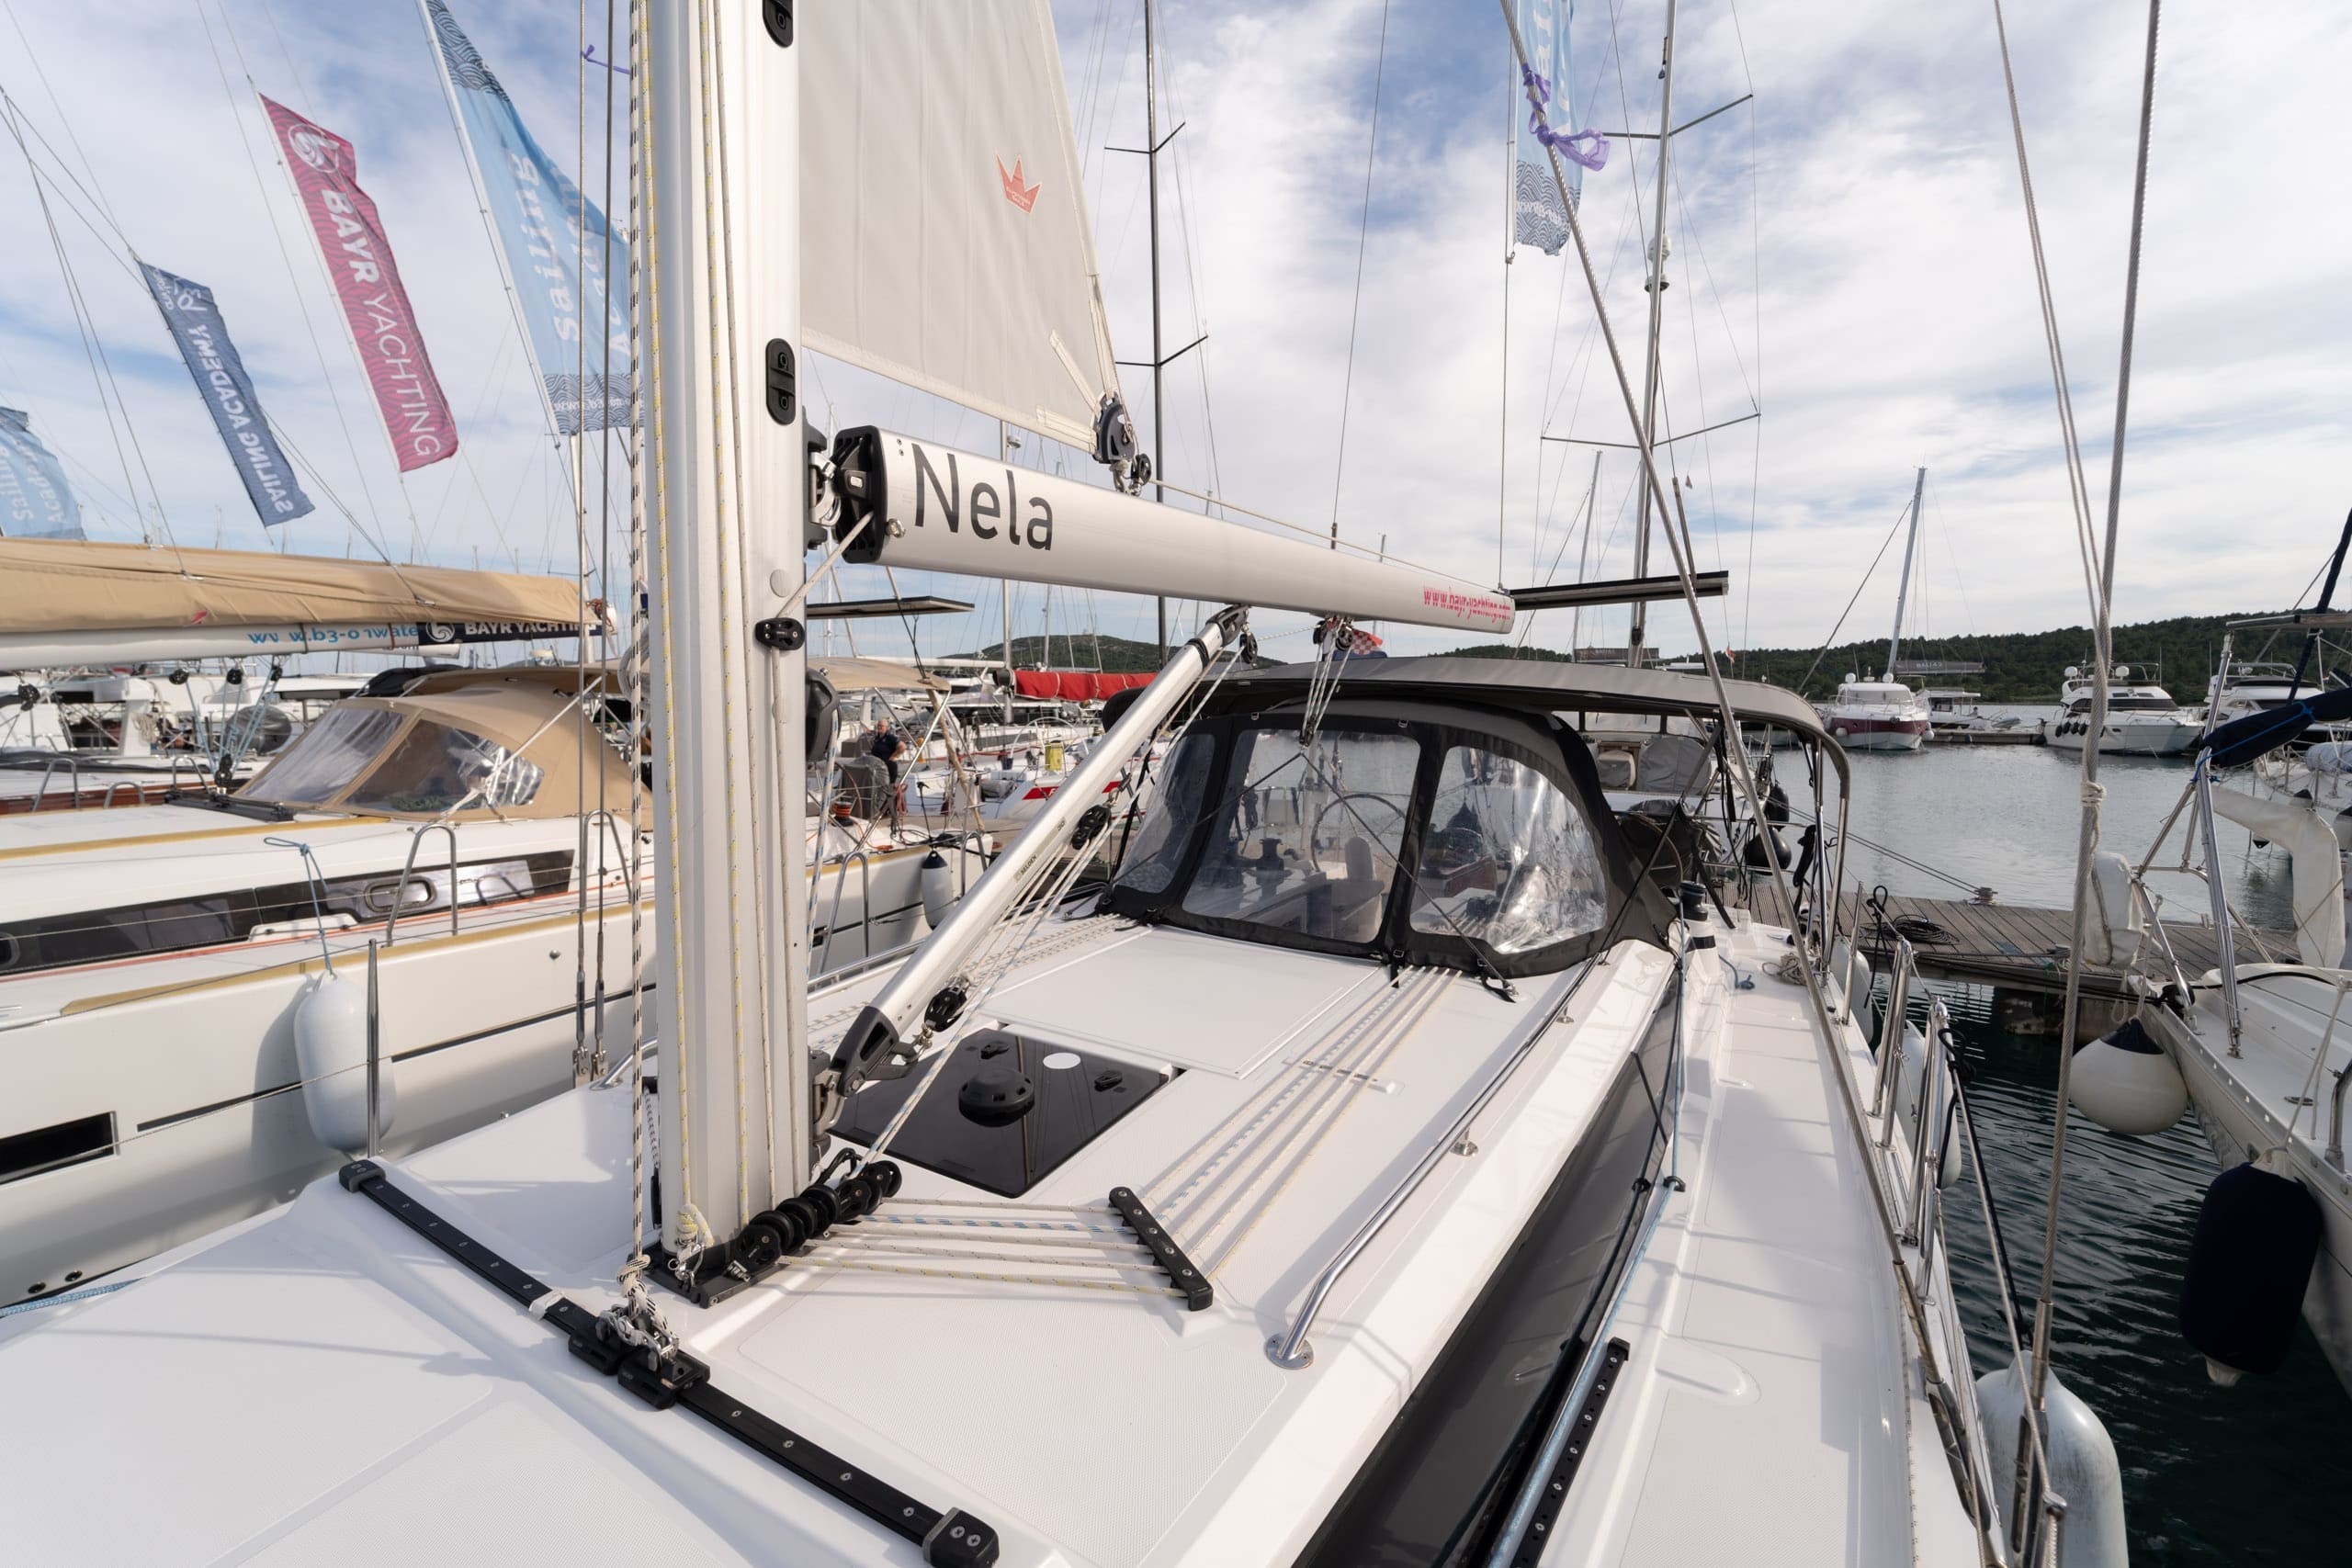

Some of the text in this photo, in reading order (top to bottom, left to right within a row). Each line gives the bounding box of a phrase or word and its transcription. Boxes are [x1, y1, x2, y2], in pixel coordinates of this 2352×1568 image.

[508, 152, 581, 343] Sailing
[321, 188, 442, 457] BAYR YACHTING
[911, 443, 1053, 551] Nela
[465, 621, 596, 636] BAYR YACHTI
